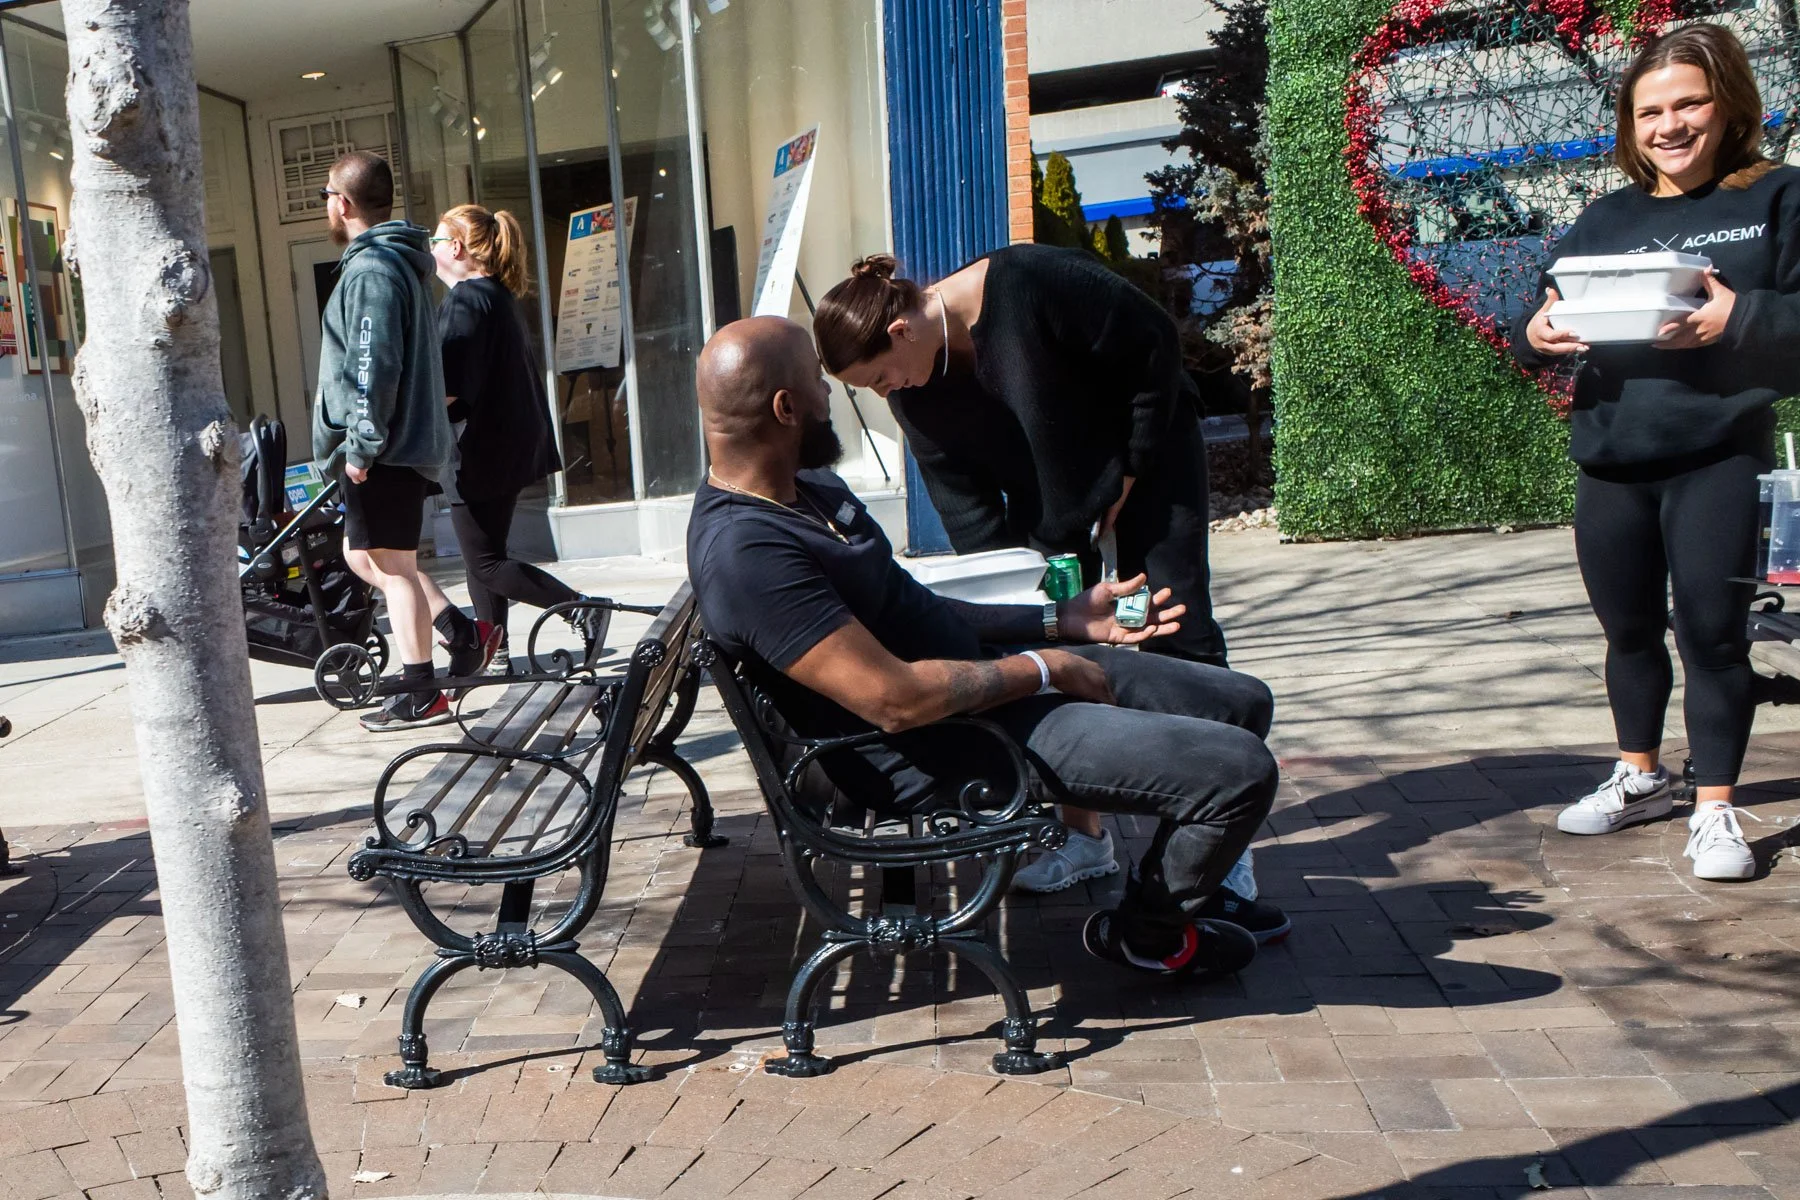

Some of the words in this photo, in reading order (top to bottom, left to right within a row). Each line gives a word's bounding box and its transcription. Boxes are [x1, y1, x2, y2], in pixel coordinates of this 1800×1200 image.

[1681, 223, 1766, 249] ACADEMY
[356, 316, 372, 417] carhartt
[288, 487, 307, 502] open
